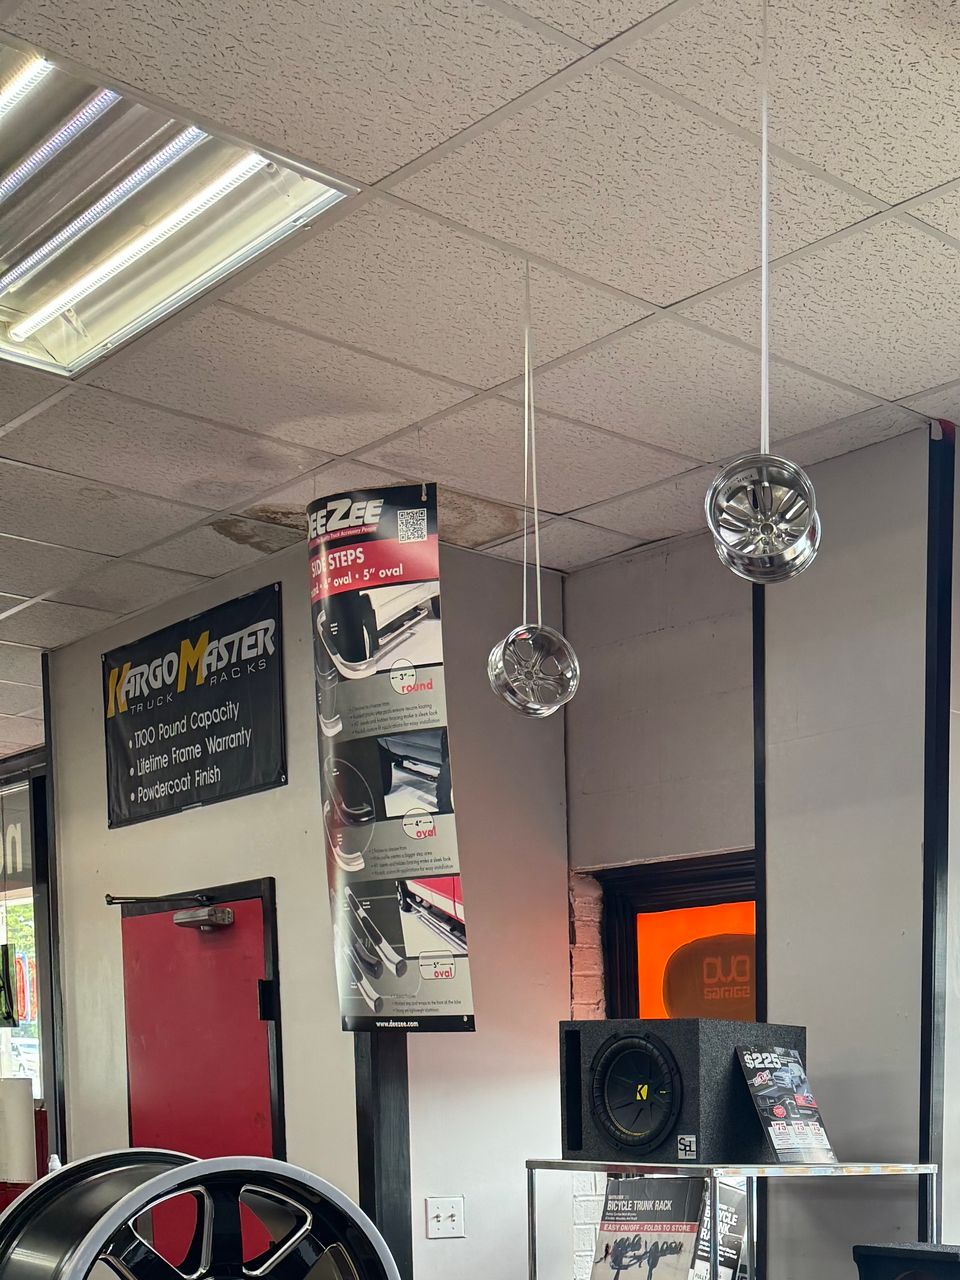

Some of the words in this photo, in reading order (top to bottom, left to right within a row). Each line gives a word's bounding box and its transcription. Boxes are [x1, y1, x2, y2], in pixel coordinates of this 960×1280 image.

[307, 499, 384, 541] EEZEE
[328, 548, 364, 570] STEPS
[333, 572, 352, 587] oval
[378, 563, 403, 577] oval
[130, 692, 173, 715] TRUCK
[209, 659, 266, 686] RACKS
[401, 679, 433, 693] round
[135, 726, 155, 749] 1700
[159, 719, 187, 742] Pound
[190, 701, 240, 730] Capacity
[137, 755, 168, 776] Lifetime
[172, 744, 202, 769] Frame
[205, 727, 252, 755] Warranty
[137, 773, 191, 803] Powdercoat
[194, 765, 221, 787] Finish
[416, 826, 436, 839] oval
[434, 967, 452, 978] oval
[376, 1019, 419, 1027] www.deezee.com
[744, 1052, 781, 1069] $225
[607, 1200, 633, 1211] BICYCLE
[633, 1200, 654, 1211] TRUNK
[654, 1200, 673, 1211] RACK
